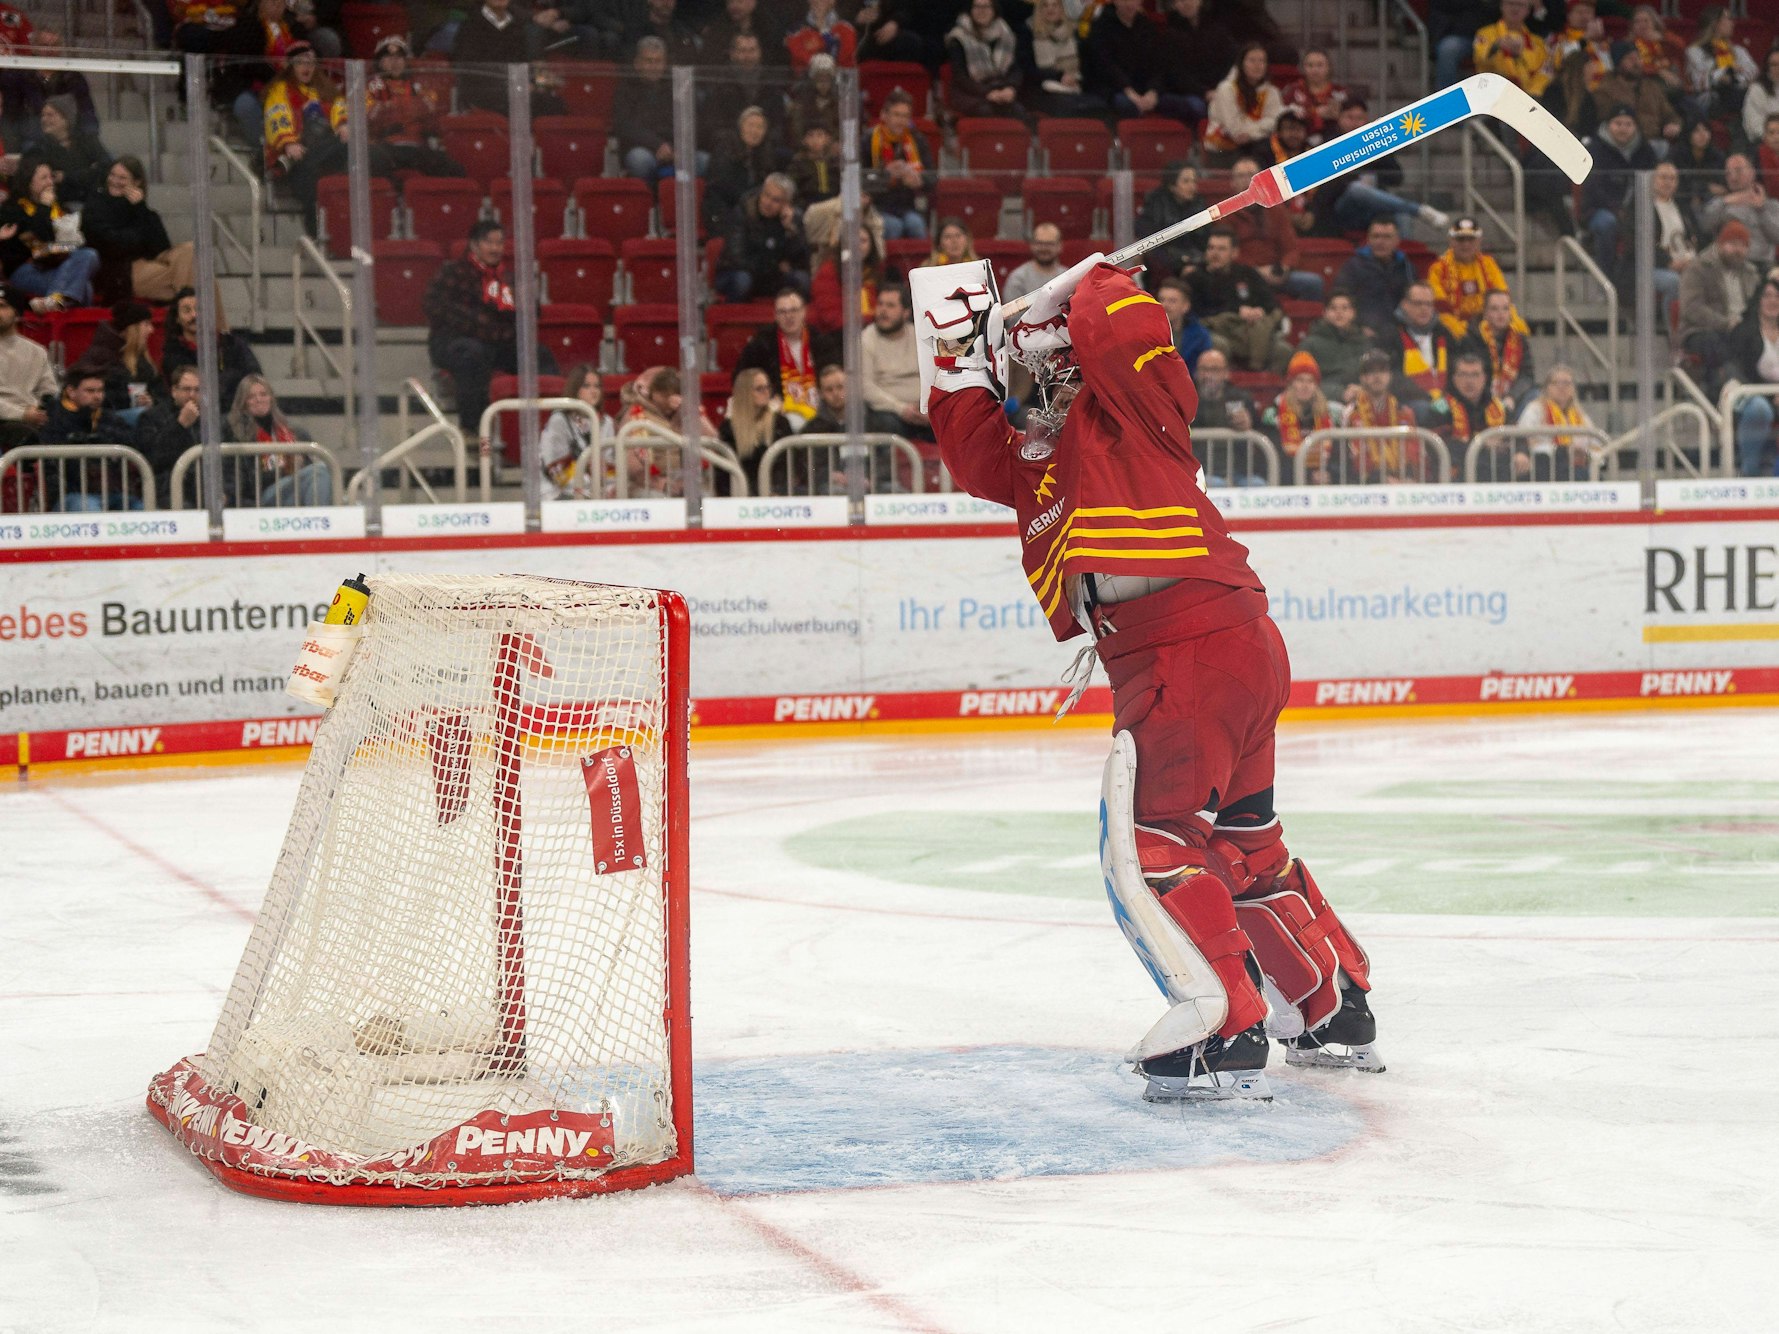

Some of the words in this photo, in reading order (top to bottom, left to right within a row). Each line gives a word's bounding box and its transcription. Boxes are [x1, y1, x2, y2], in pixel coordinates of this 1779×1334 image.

[1362, 123, 1394, 142] reisen
[1332, 133, 1398, 170] schauinsland
[577, 508, 650, 523] D.SPORTS
[738, 505, 812, 519] D.SPORTS
[874, 501, 948, 516] D.SPORTS
[30, 523, 99, 539] D.SPORTS
[107, 520, 177, 536] D.SPORTS
[259, 515, 331, 532] D.SPORTS
[418, 512, 490, 528] D.SPORTS
[1643, 545, 1777, 613] RHE
[0, 605, 88, 641] ebes
[899, 597, 944, 631] Ihr
[95, 681, 169, 701] bauen
[179, 676, 223, 695] und
[233, 677, 290, 693] man
[242, 720, 320, 747] PENN
[601, 757, 623, 823] Düsseldorf
[611, 825, 624, 838] in
[614, 840, 626, 864] 15x
